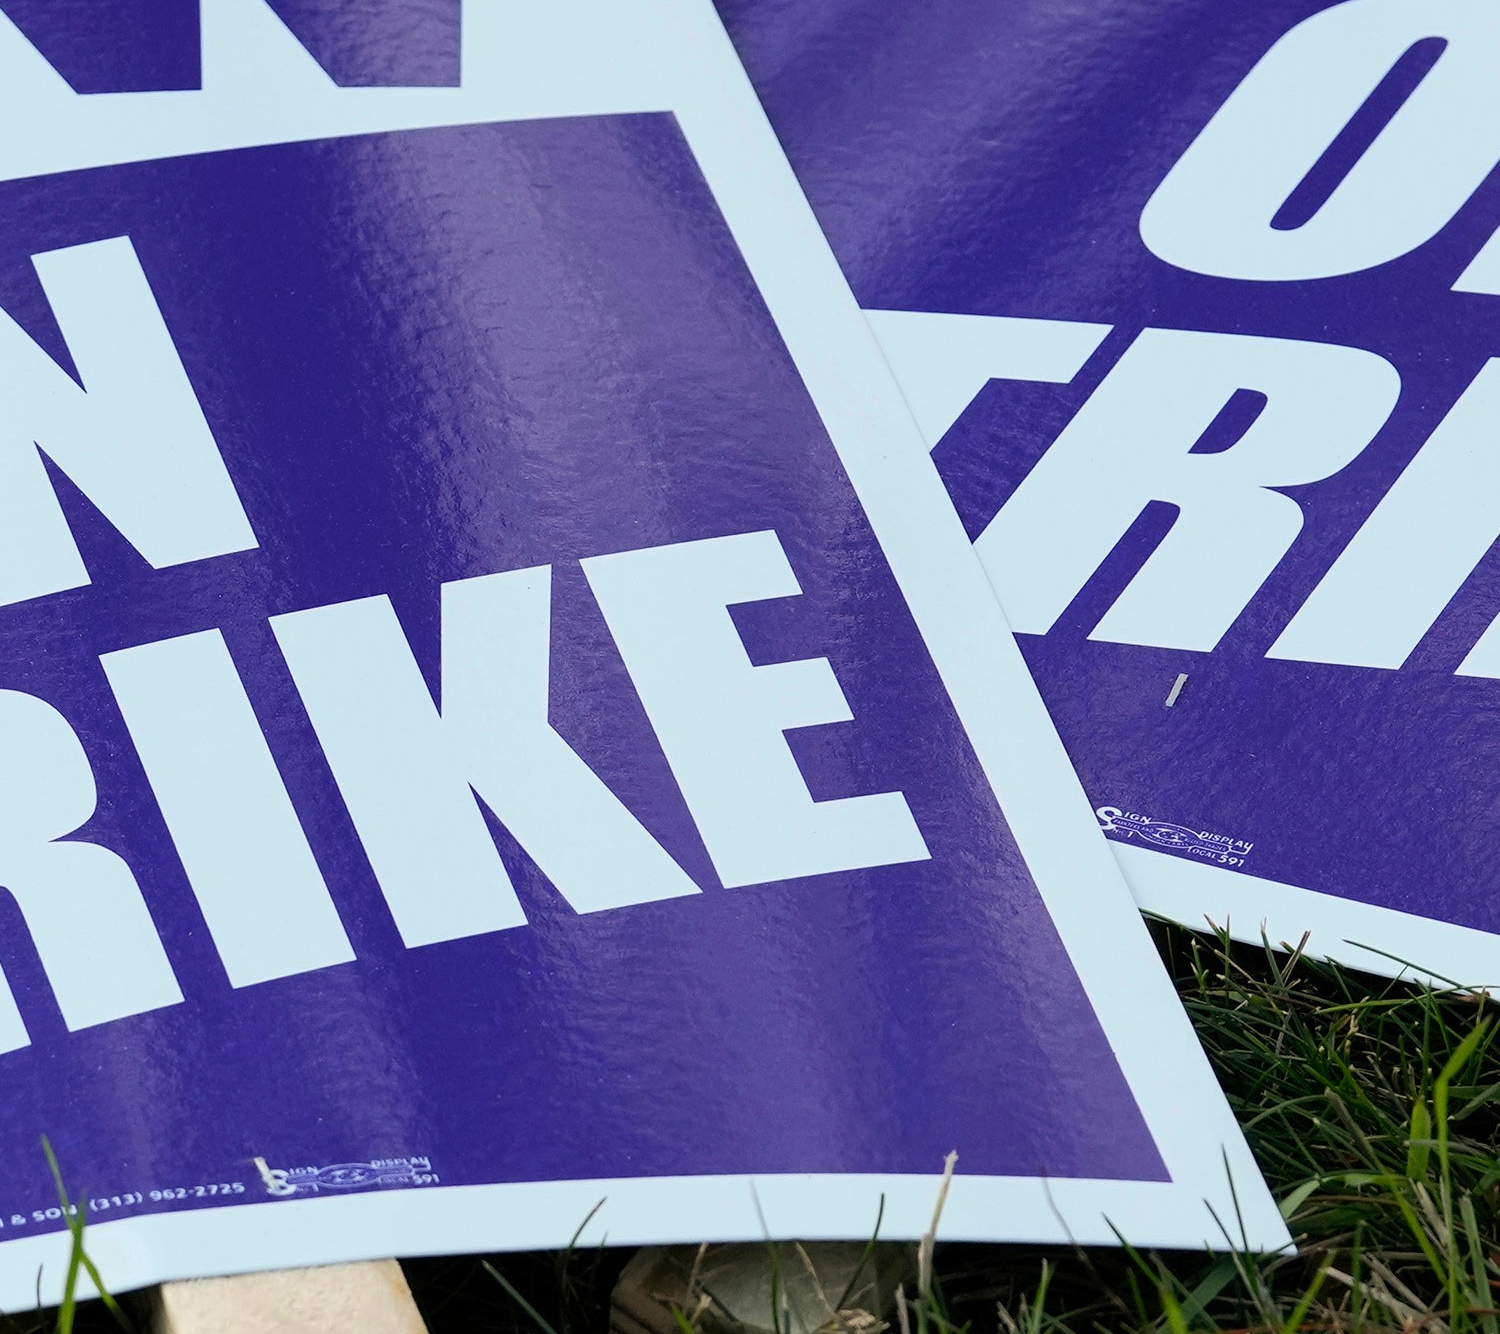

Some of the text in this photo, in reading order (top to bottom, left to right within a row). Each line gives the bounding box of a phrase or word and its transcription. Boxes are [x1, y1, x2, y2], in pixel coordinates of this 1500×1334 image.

[1199, 831, 1254, 855] DISPLAY
[1187, 847, 1245, 867] LOCAL 591
[371, 1156, 432, 1171] DISPLAY
[412, 1173, 441, 1185] 591
[10, 1213, 27, 1226] &
[32, 1204, 78, 1222] SON
[89, 1191, 144, 1213] (313)
[149, 1182, 246, 1202] 962-2725
